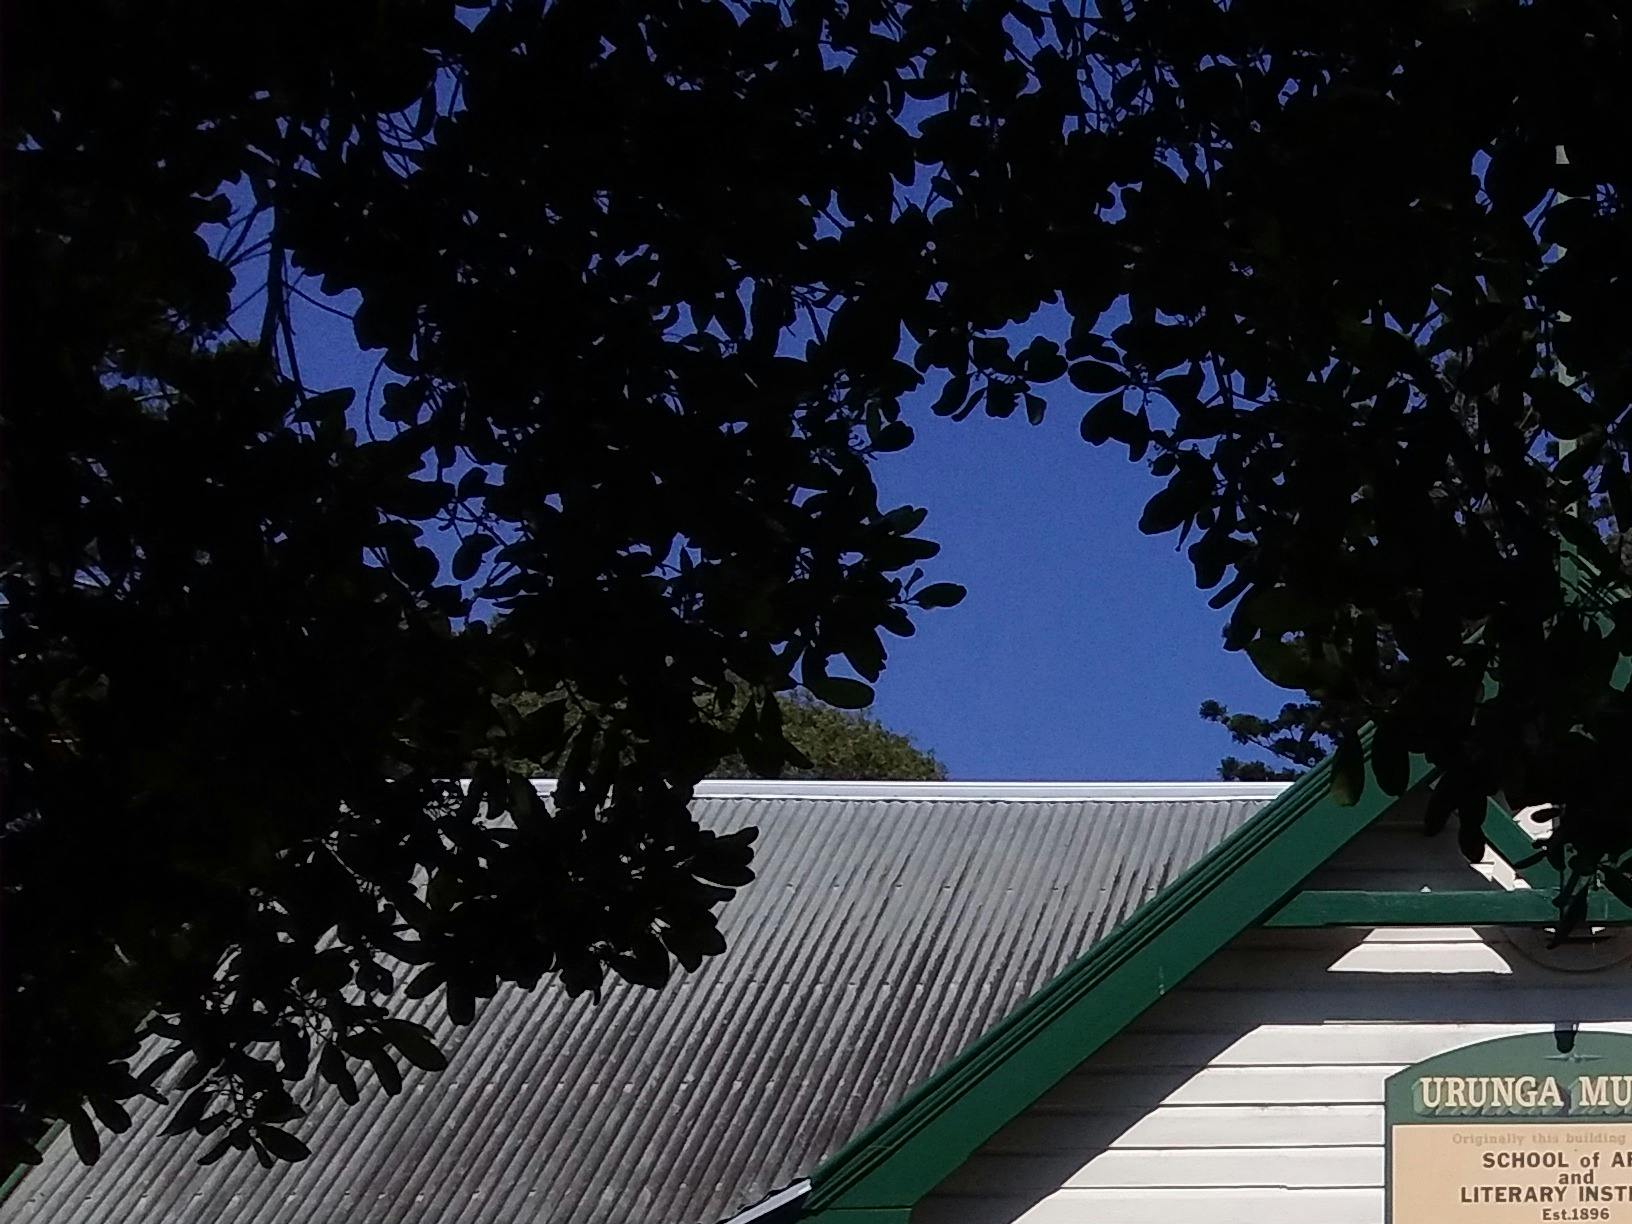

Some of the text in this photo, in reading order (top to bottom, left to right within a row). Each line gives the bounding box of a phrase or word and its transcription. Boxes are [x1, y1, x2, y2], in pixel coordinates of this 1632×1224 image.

[1419, 1076, 1564, 1108] URUNGA
[1452, 1132, 1524, 1145] Originally
[1532, 1132, 1559, 1143] this
[1566, 1131, 1626, 1145] building
[1483, 1152, 1569, 1168] SCHOOL
[1580, 1152, 1599, 1167] of
[1559, 1170, 1594, 1184] and
[1461, 1186, 1566, 1202] LITERARY
